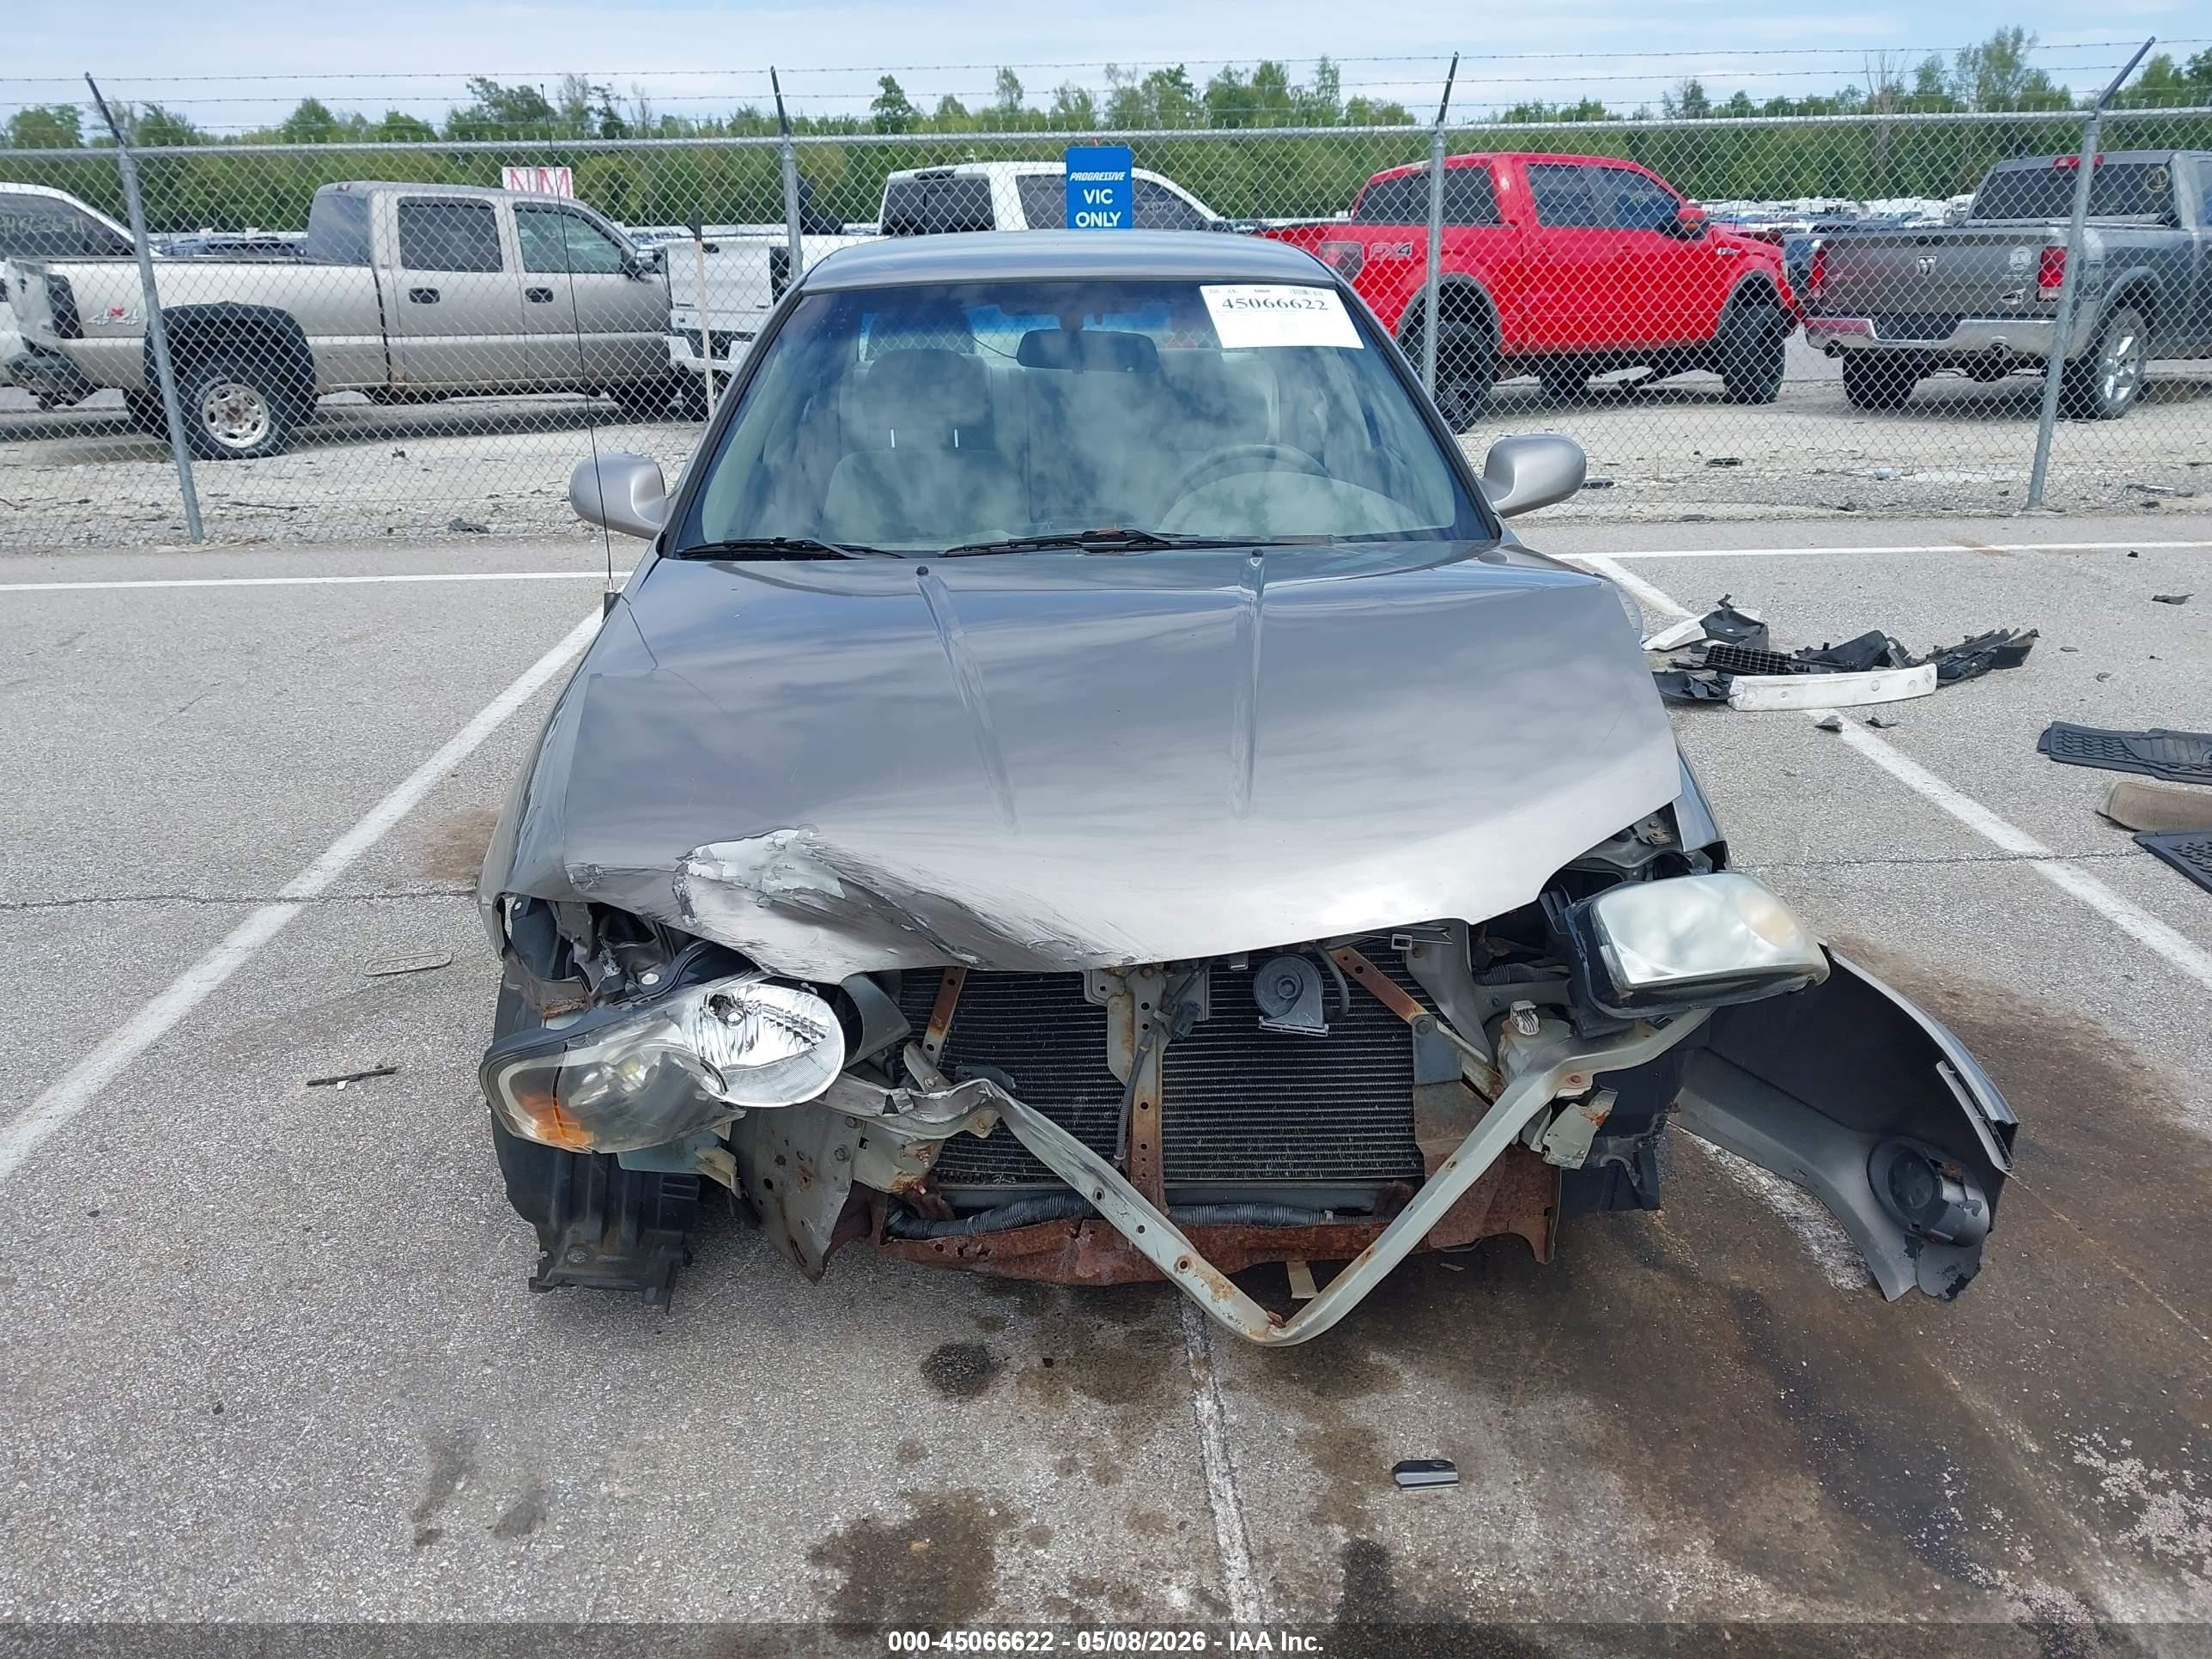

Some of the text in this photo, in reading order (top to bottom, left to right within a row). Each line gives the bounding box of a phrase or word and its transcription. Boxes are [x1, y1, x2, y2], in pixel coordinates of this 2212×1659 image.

[1069, 172, 1127, 181] PROGRESSIVE
[1083, 189, 1114, 204] VIC
[1075, 212, 1121, 228] ONLY
[1370, 242, 1413, 260] FX4
[1222, 298, 1329, 311] 45066622
